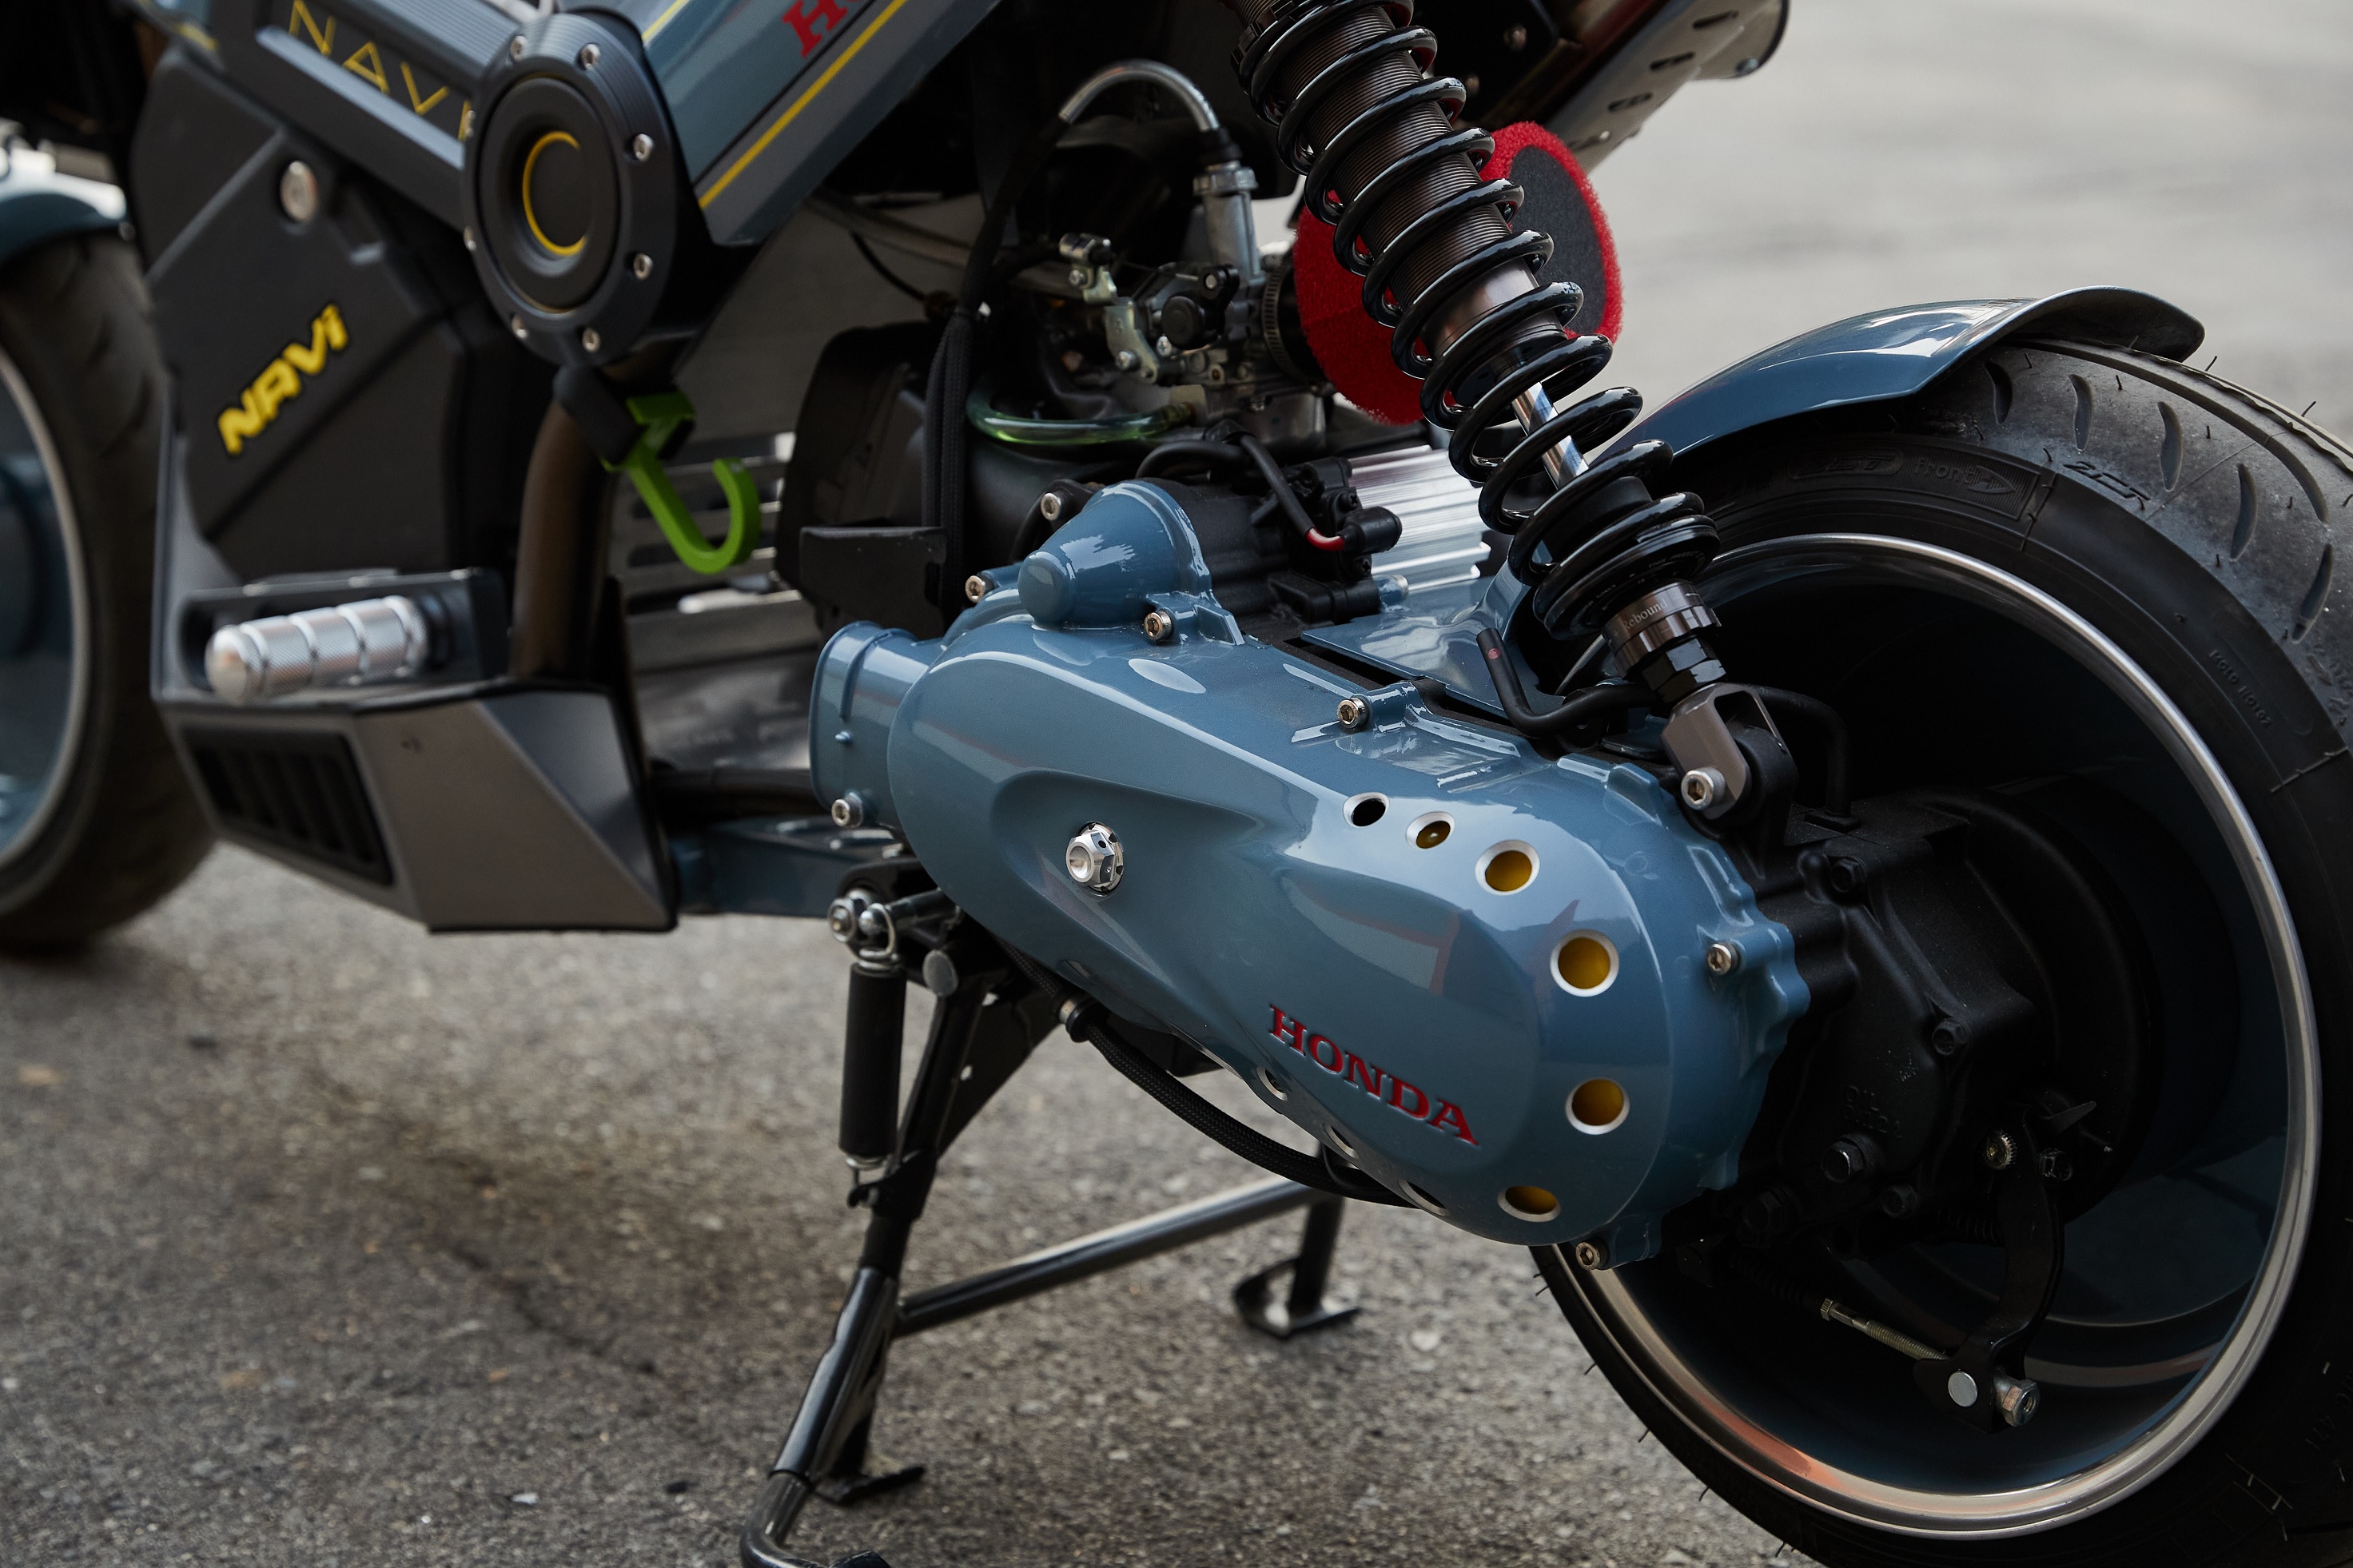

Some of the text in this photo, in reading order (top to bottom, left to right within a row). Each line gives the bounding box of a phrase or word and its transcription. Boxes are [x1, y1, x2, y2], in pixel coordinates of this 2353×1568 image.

[782, 0, 858, 58] H
[289, 0, 471, 141] NAVI
[1913, 458, 1977, 484] front
[1623, 599, 1669, 630] Rebound
[1269, 1003, 1479, 1146] HONDA
